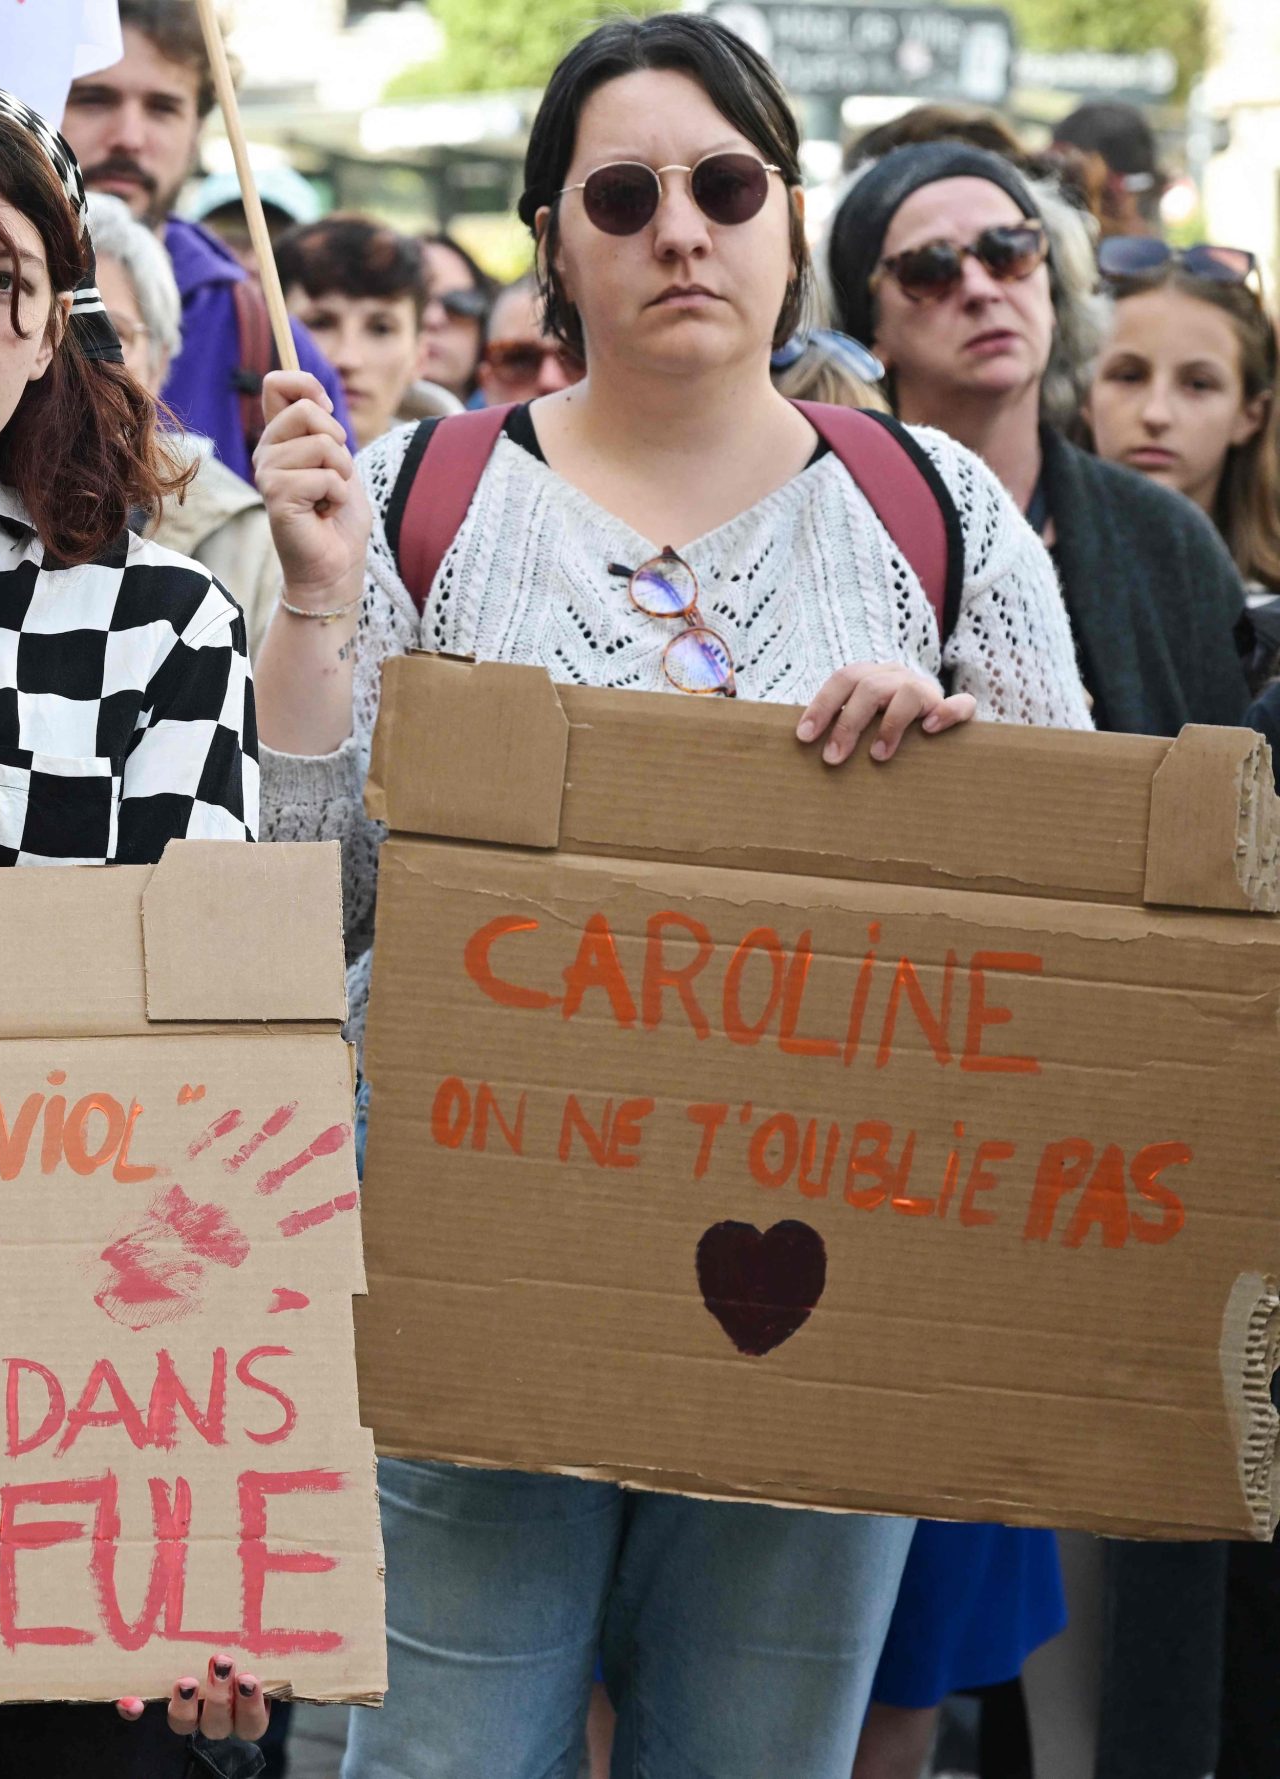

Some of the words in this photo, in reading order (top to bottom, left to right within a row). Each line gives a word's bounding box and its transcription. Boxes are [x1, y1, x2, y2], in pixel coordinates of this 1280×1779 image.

[431, 1076, 526, 1157] ON
[558, 1093, 655, 1168] NE
[1021, 1136, 1194, 1250] PAS
[2, 1345, 296, 1459] DANS
